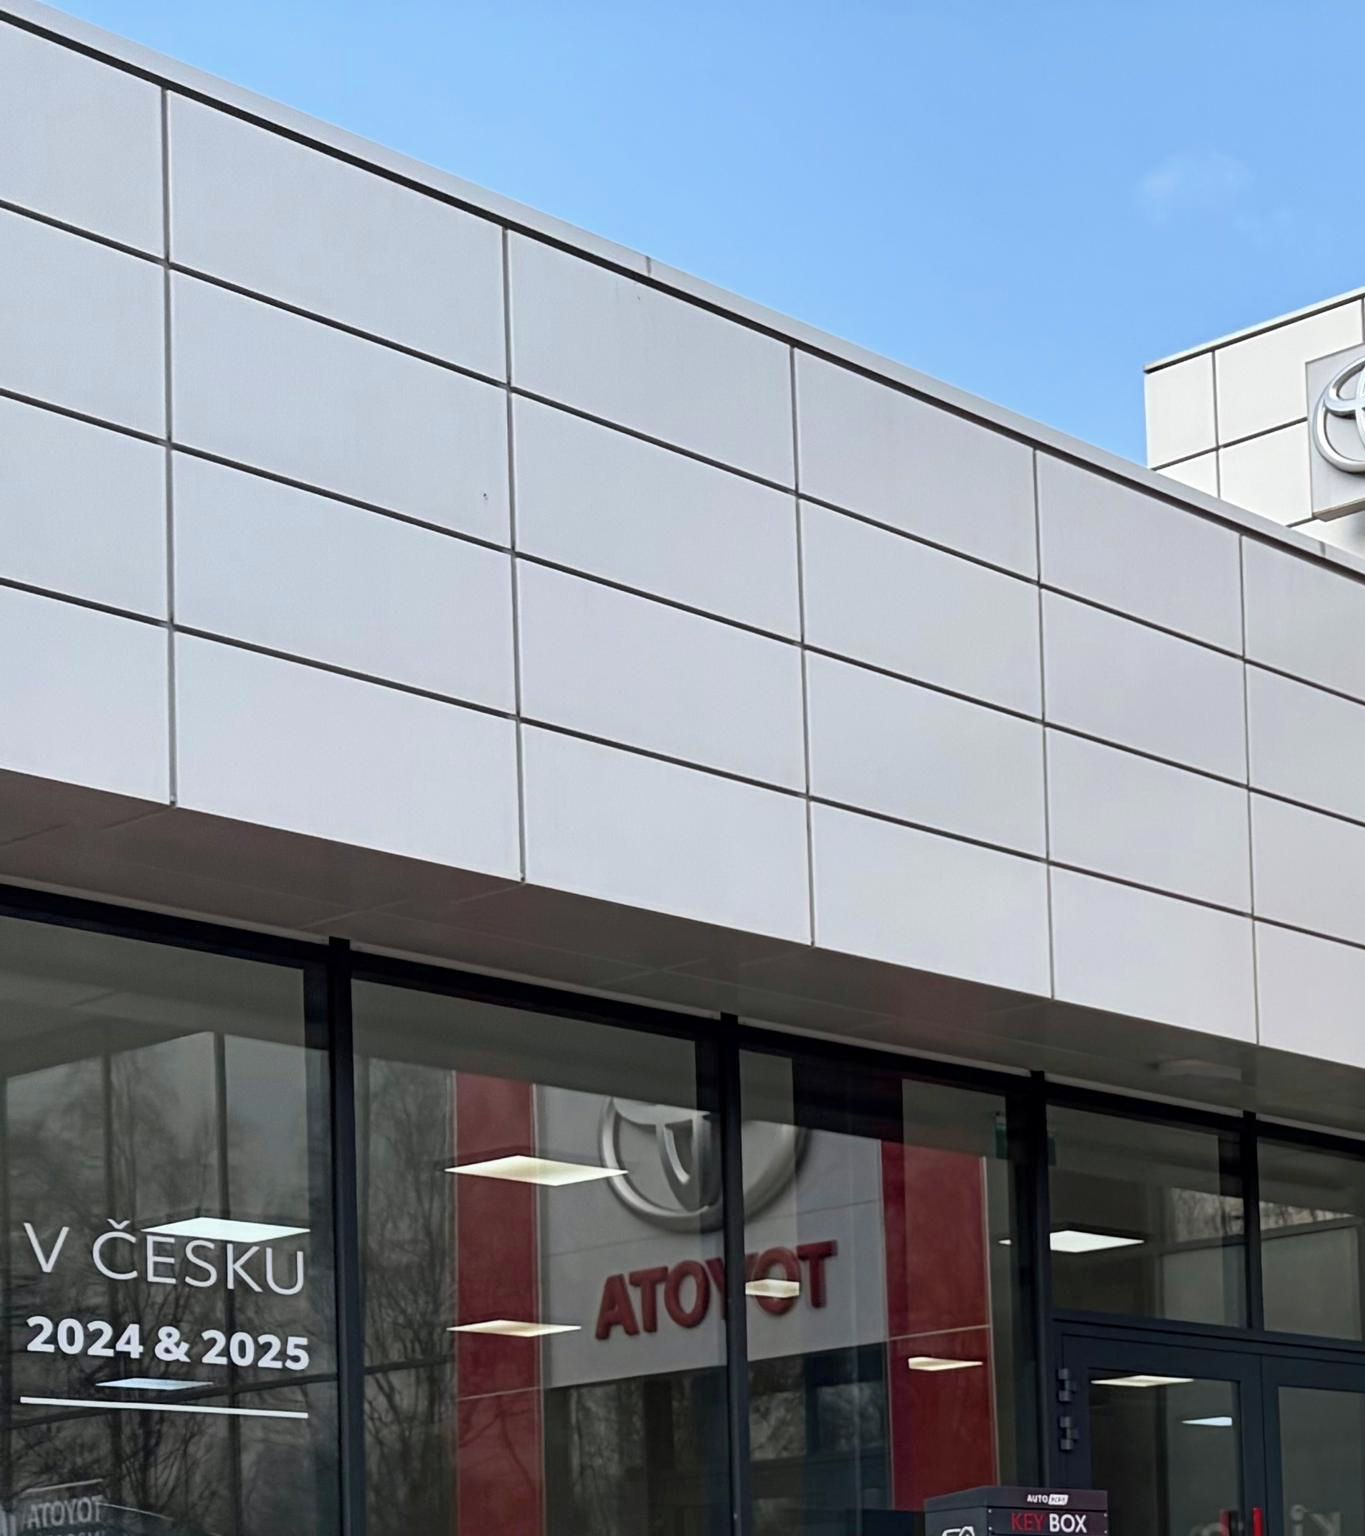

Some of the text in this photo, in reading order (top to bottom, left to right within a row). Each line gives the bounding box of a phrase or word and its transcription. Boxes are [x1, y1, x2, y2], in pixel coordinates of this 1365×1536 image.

[23, 1218, 304, 1295] V ČESKU
[26, 1315, 310, 1371] 2024 & 2025
[1011, 1512, 1087, 1533] KEY BOX
